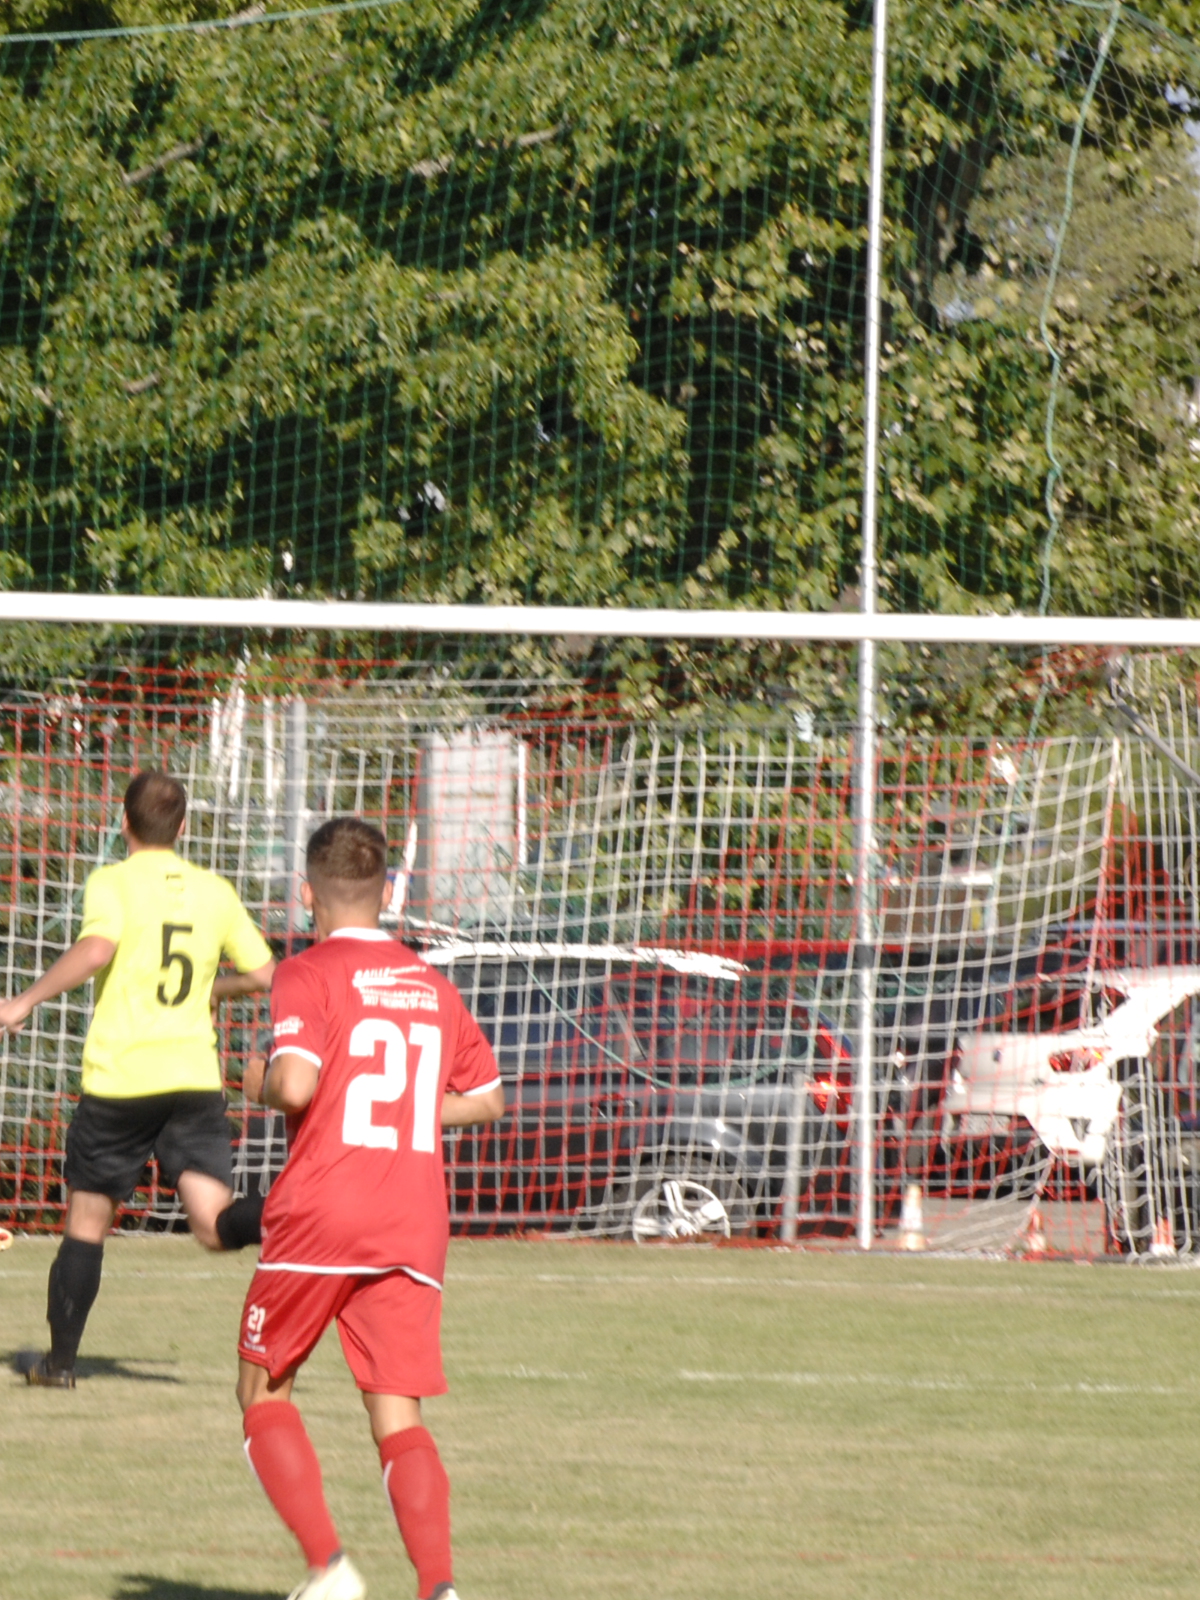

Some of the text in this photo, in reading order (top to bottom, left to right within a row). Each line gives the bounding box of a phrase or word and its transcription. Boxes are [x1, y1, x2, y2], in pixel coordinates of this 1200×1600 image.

[156, 922, 194, 1007] 5
[342, 1018, 442, 1154] 21
[247, 1303, 266, 1333] 21
